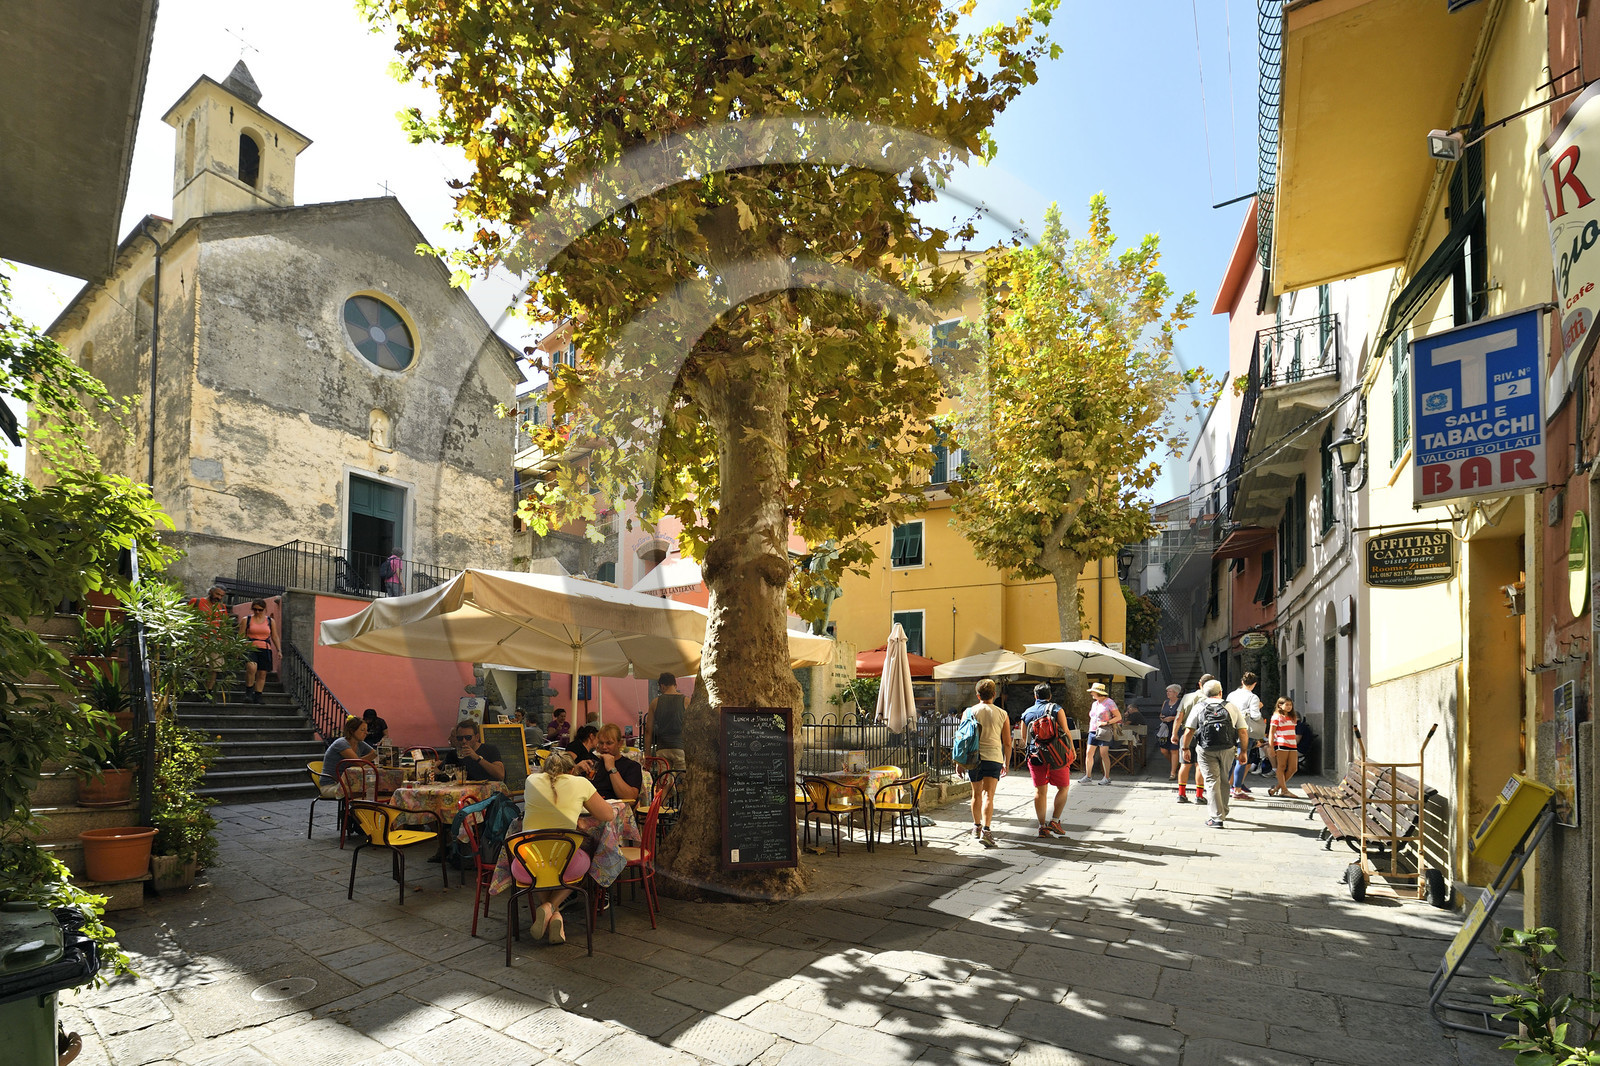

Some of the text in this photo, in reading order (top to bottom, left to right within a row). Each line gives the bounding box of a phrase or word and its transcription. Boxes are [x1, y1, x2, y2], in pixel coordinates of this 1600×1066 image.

[1431, 328, 1518, 409] T
[1493, 371, 1515, 383] RIV.
[1507, 384, 1518, 396] 2
[1445, 405, 1507, 427] SALI E
[1421, 414, 1535, 450] TABACCHI
[1421, 436, 1536, 464] VALORI BOLLATI
[1422, 449, 1537, 496] BAR
[1370, 533, 1447, 551] AFFITTASI
[1374, 546, 1445, 560] CAMERE
[1384, 557, 1408, 565] vista
